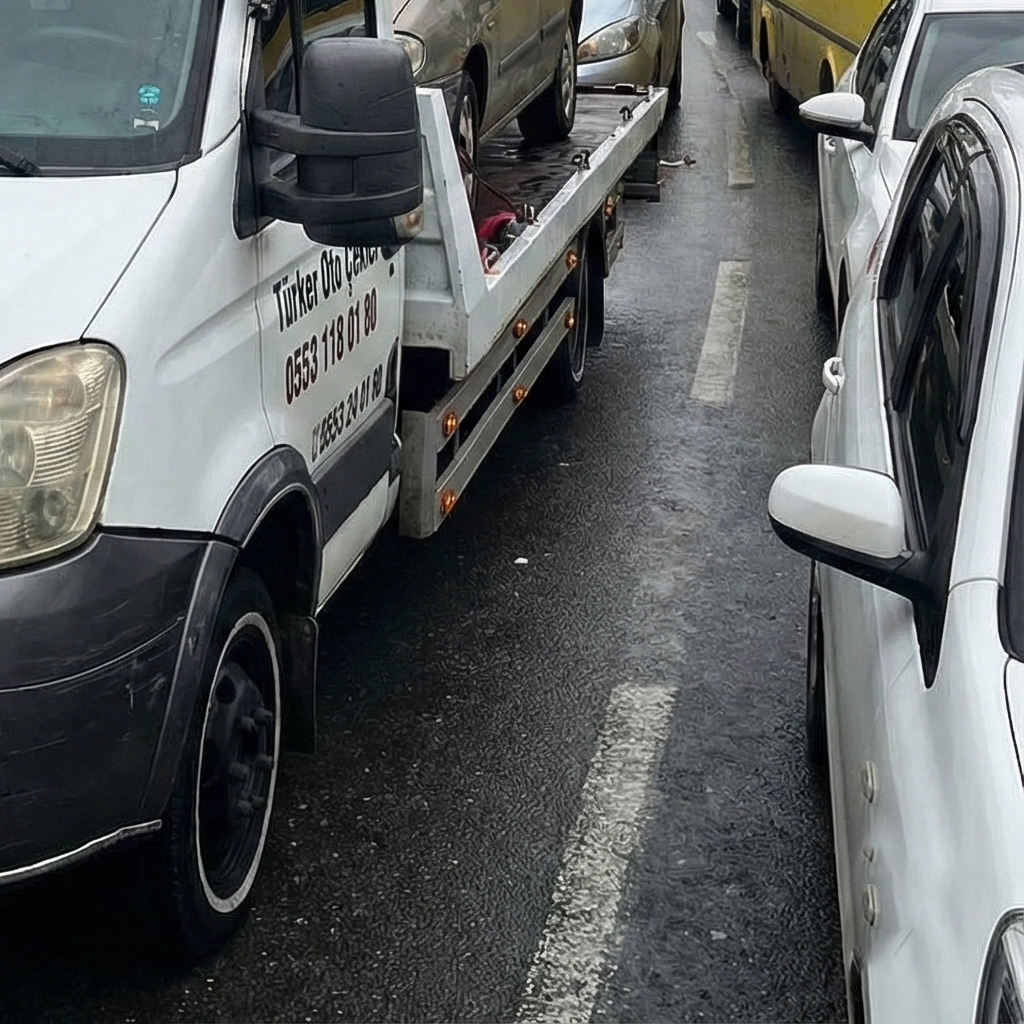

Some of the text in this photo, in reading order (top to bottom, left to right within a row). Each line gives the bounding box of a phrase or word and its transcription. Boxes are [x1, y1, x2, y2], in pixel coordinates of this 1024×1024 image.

[273, 269, 319, 333] Türker
[320, 249, 342, 300] Oto
[285, 287, 377, 405] 0553 118 01 80
